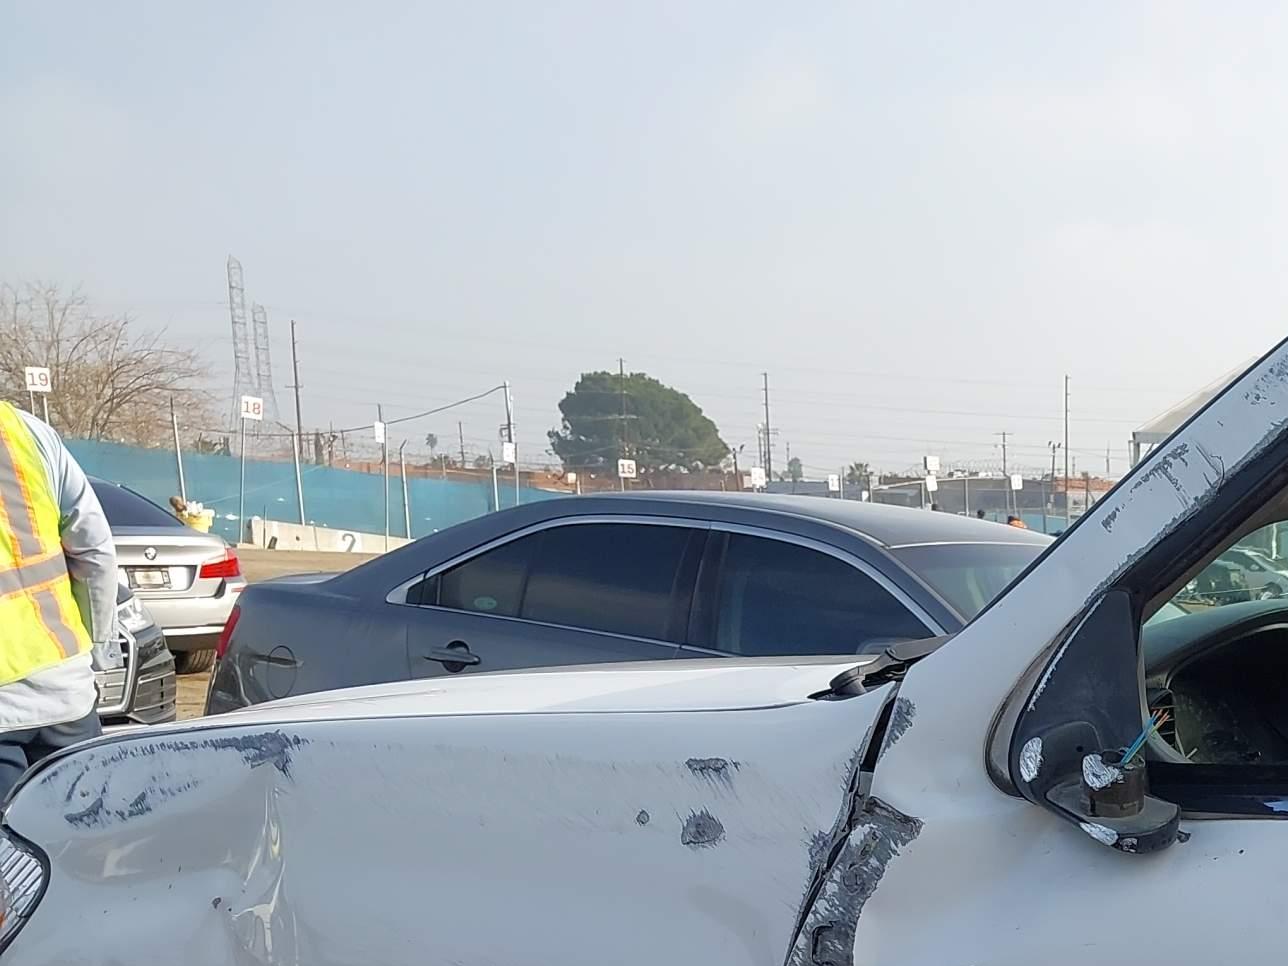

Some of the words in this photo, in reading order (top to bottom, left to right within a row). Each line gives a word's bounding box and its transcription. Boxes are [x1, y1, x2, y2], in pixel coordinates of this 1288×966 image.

[28, 372, 48, 387] 19
[243, 401, 261, 415] 18
[620, 463, 635, 475] 15
